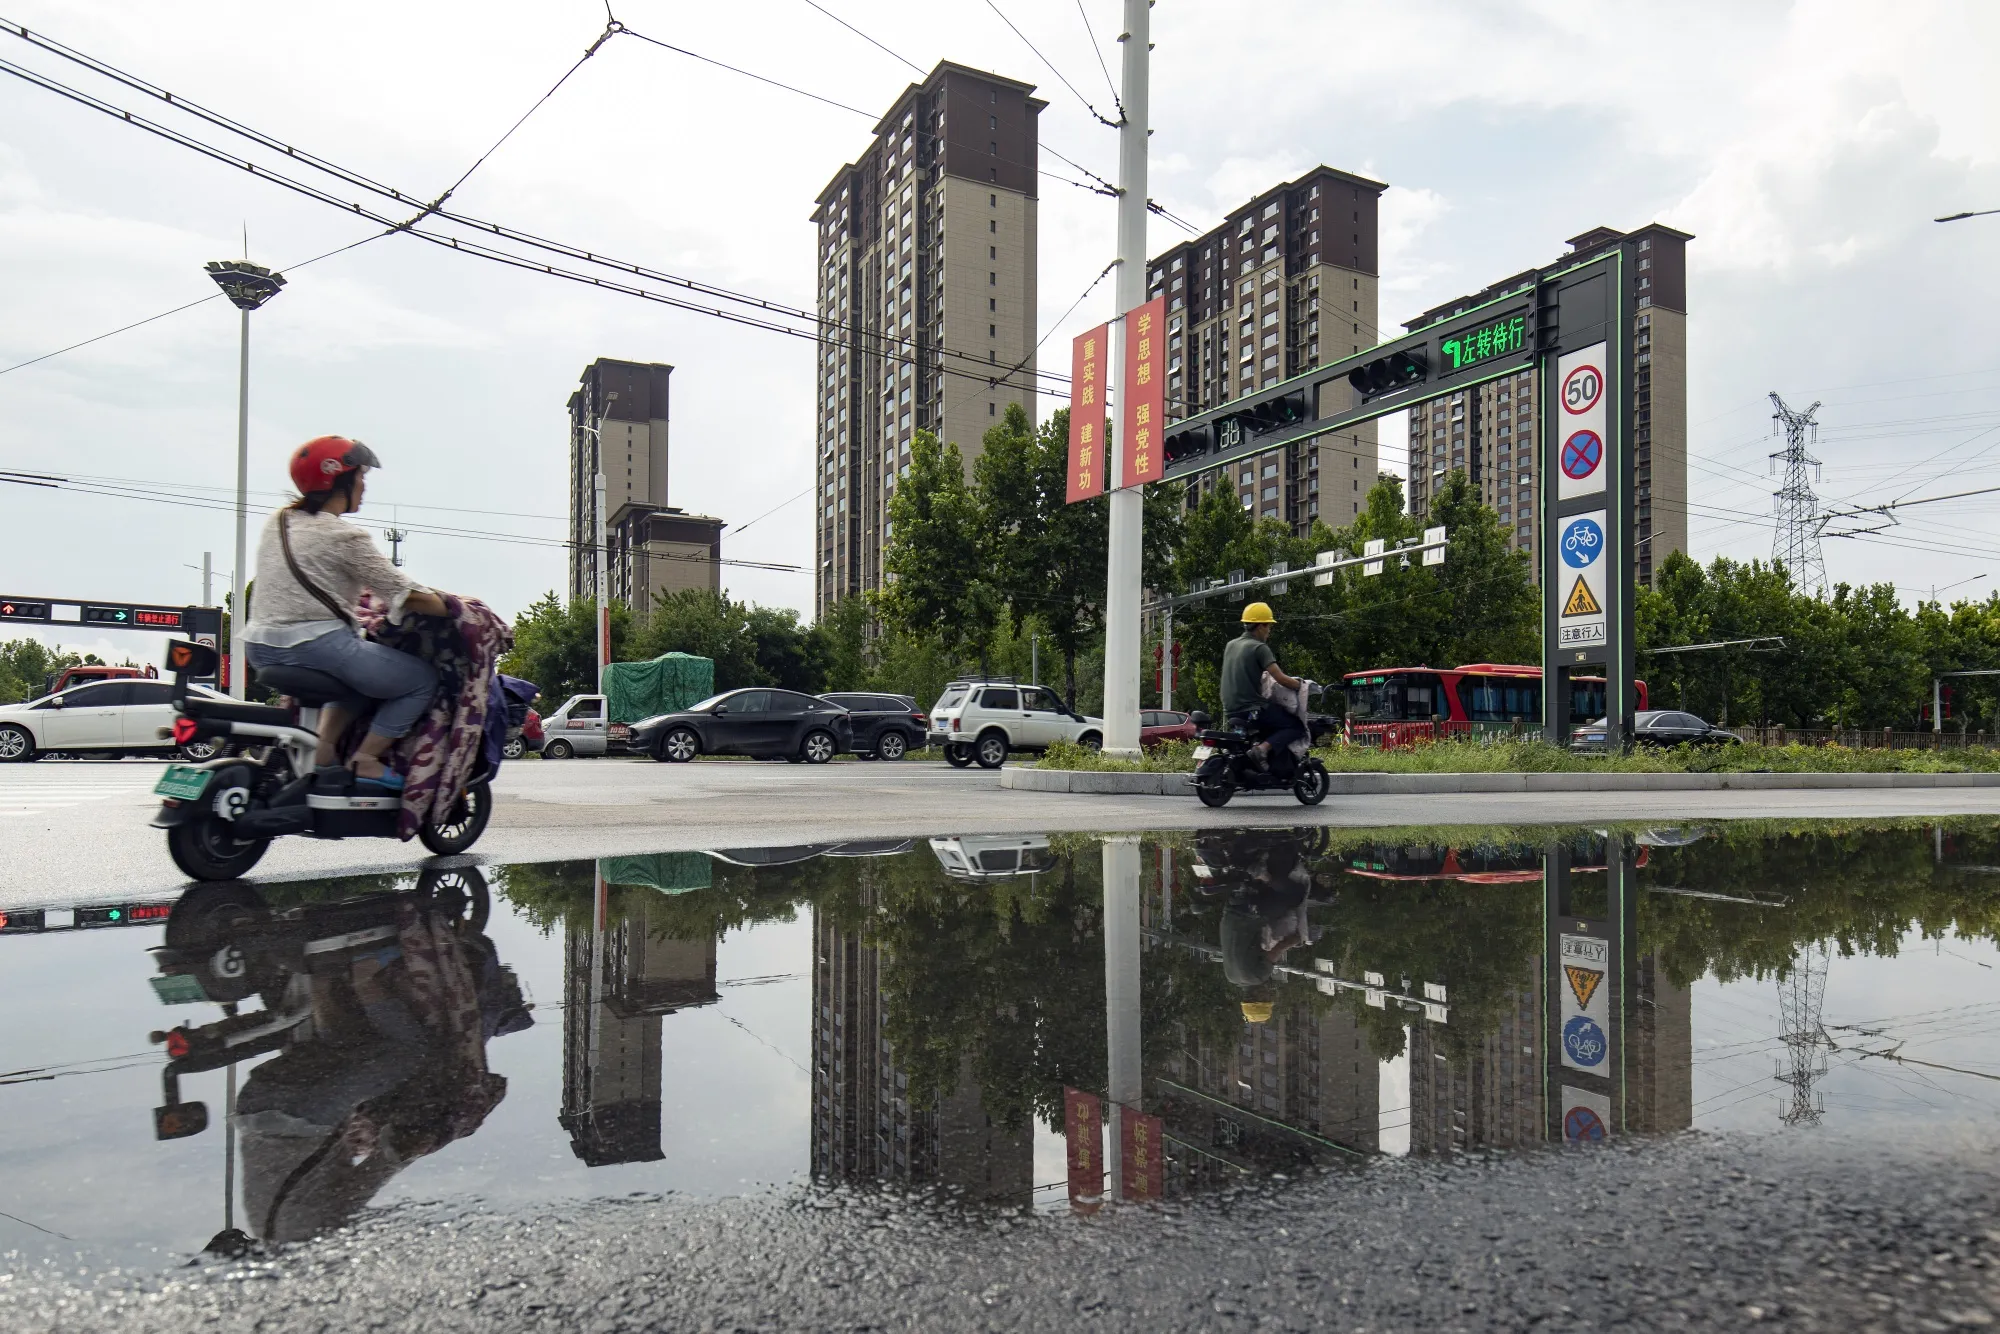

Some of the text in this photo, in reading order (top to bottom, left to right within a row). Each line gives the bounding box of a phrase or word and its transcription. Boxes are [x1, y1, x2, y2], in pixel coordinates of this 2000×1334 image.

[1462, 317, 1524, 364] 左转待行
[1135, 313, 1151, 475] 学思想 强党性
[1567, 374, 1597, 406] 50
[1079, 338, 1096, 490] 重实践 建新功
[1562, 625, 1602, 640] 注意行人
